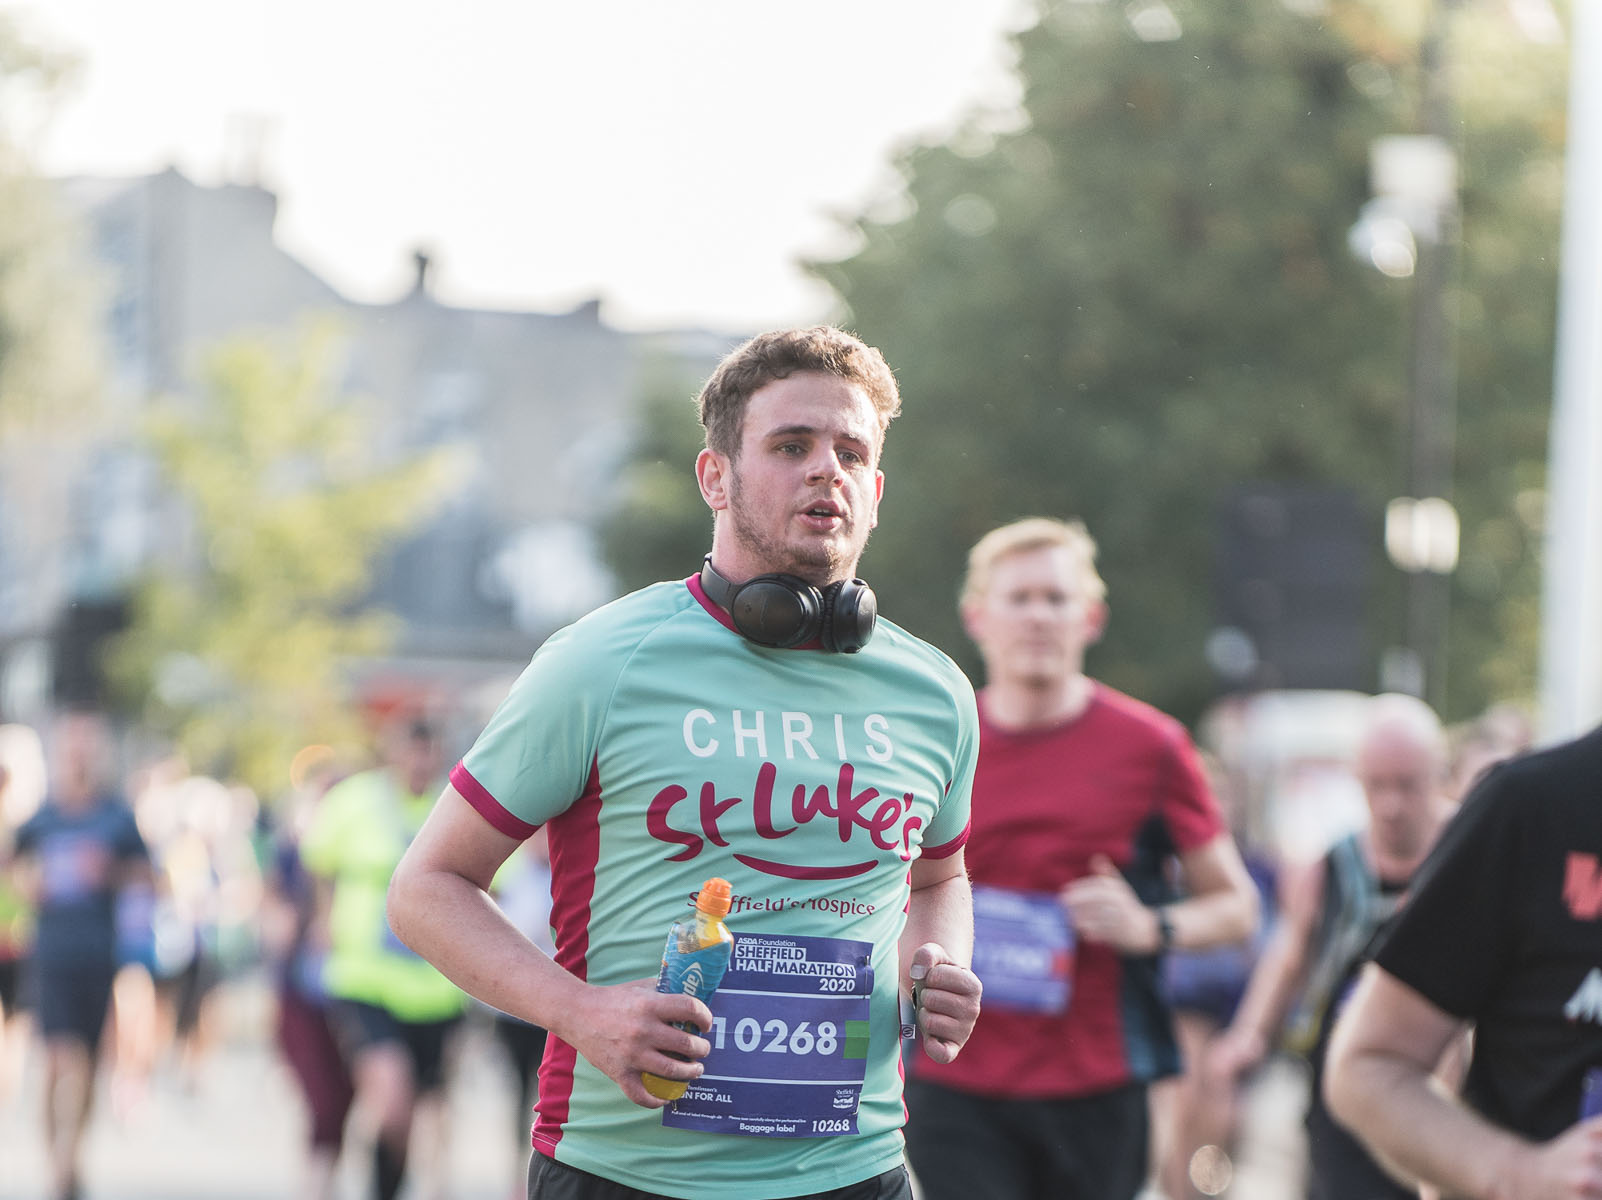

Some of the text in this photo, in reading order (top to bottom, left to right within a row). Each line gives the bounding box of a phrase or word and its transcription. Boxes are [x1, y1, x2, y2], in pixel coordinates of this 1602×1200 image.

[683, 709, 894, 762] CHRIS
[646, 762, 922, 862] St Luke's
[738, 937, 796, 947] ASDA Foundation
[737, 945, 804, 960] SHEFFIELD
[736, 959, 772, 972] HALF
[774, 962, 855, 977] MARATHON
[819, 978, 856, 992] 2020
[712, 1016, 838, 1055] 10268
[694, 1092, 713, 1101] FOR
[715, 1094, 733, 1103] ALL
[739, 1123, 796, 1133] Baggage label
[812, 1119, 850, 1132] 10268
